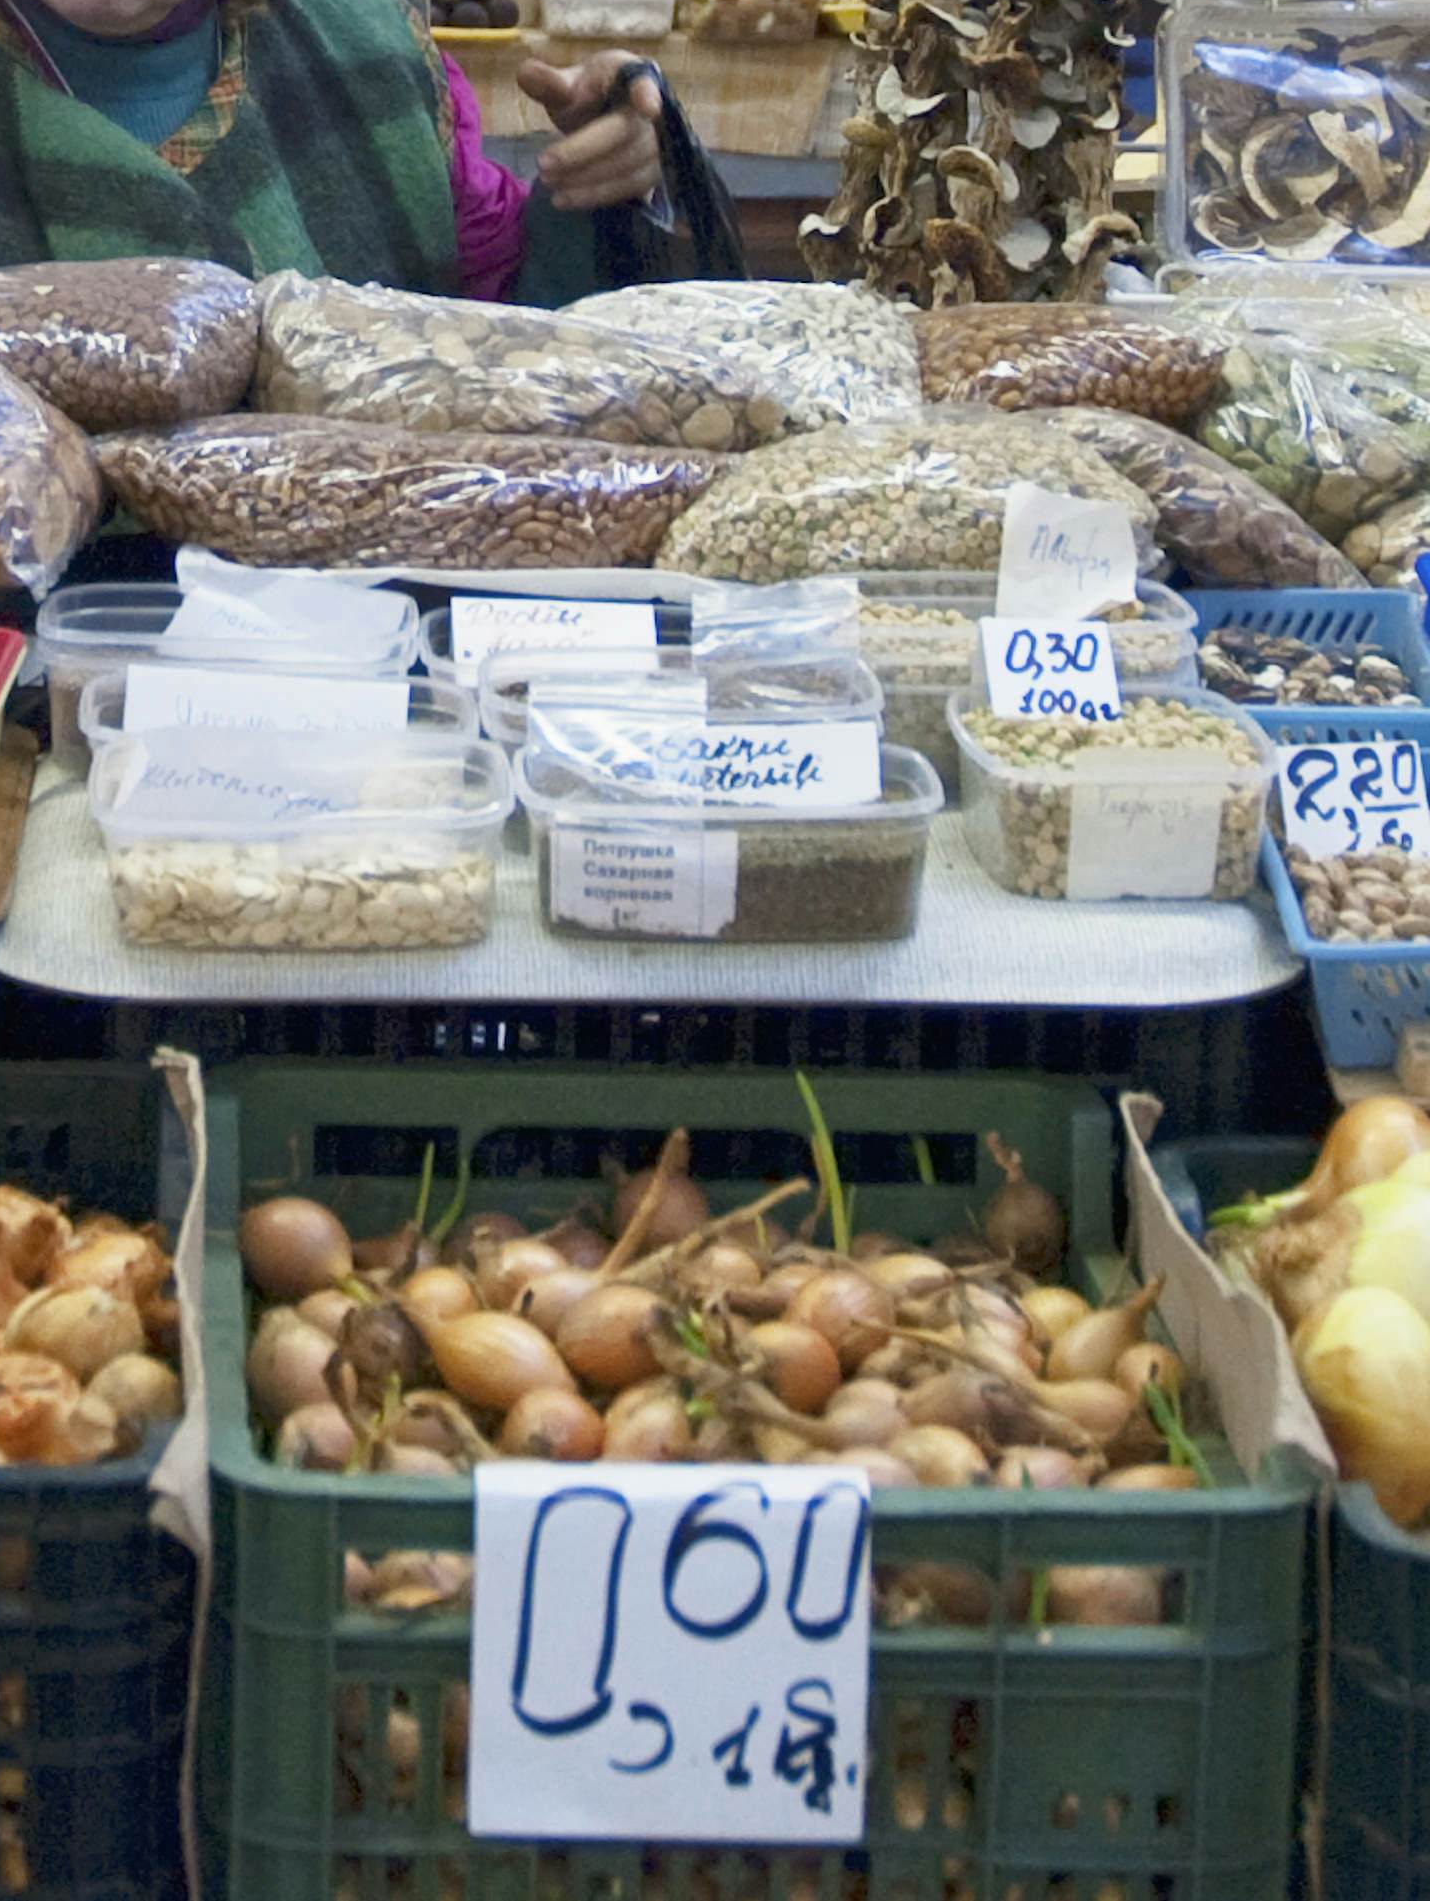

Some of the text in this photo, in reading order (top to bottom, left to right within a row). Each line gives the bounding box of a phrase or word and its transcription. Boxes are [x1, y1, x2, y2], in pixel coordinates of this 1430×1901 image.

[1004, 628, 1099, 680] 0,30
[1287, 743, 1418, 851] 2,20
[583, 860, 674, 880] Сахарная
[584, 839, 675, 859] Петрушка
[510, 1482, 869, 1775] 0,60
